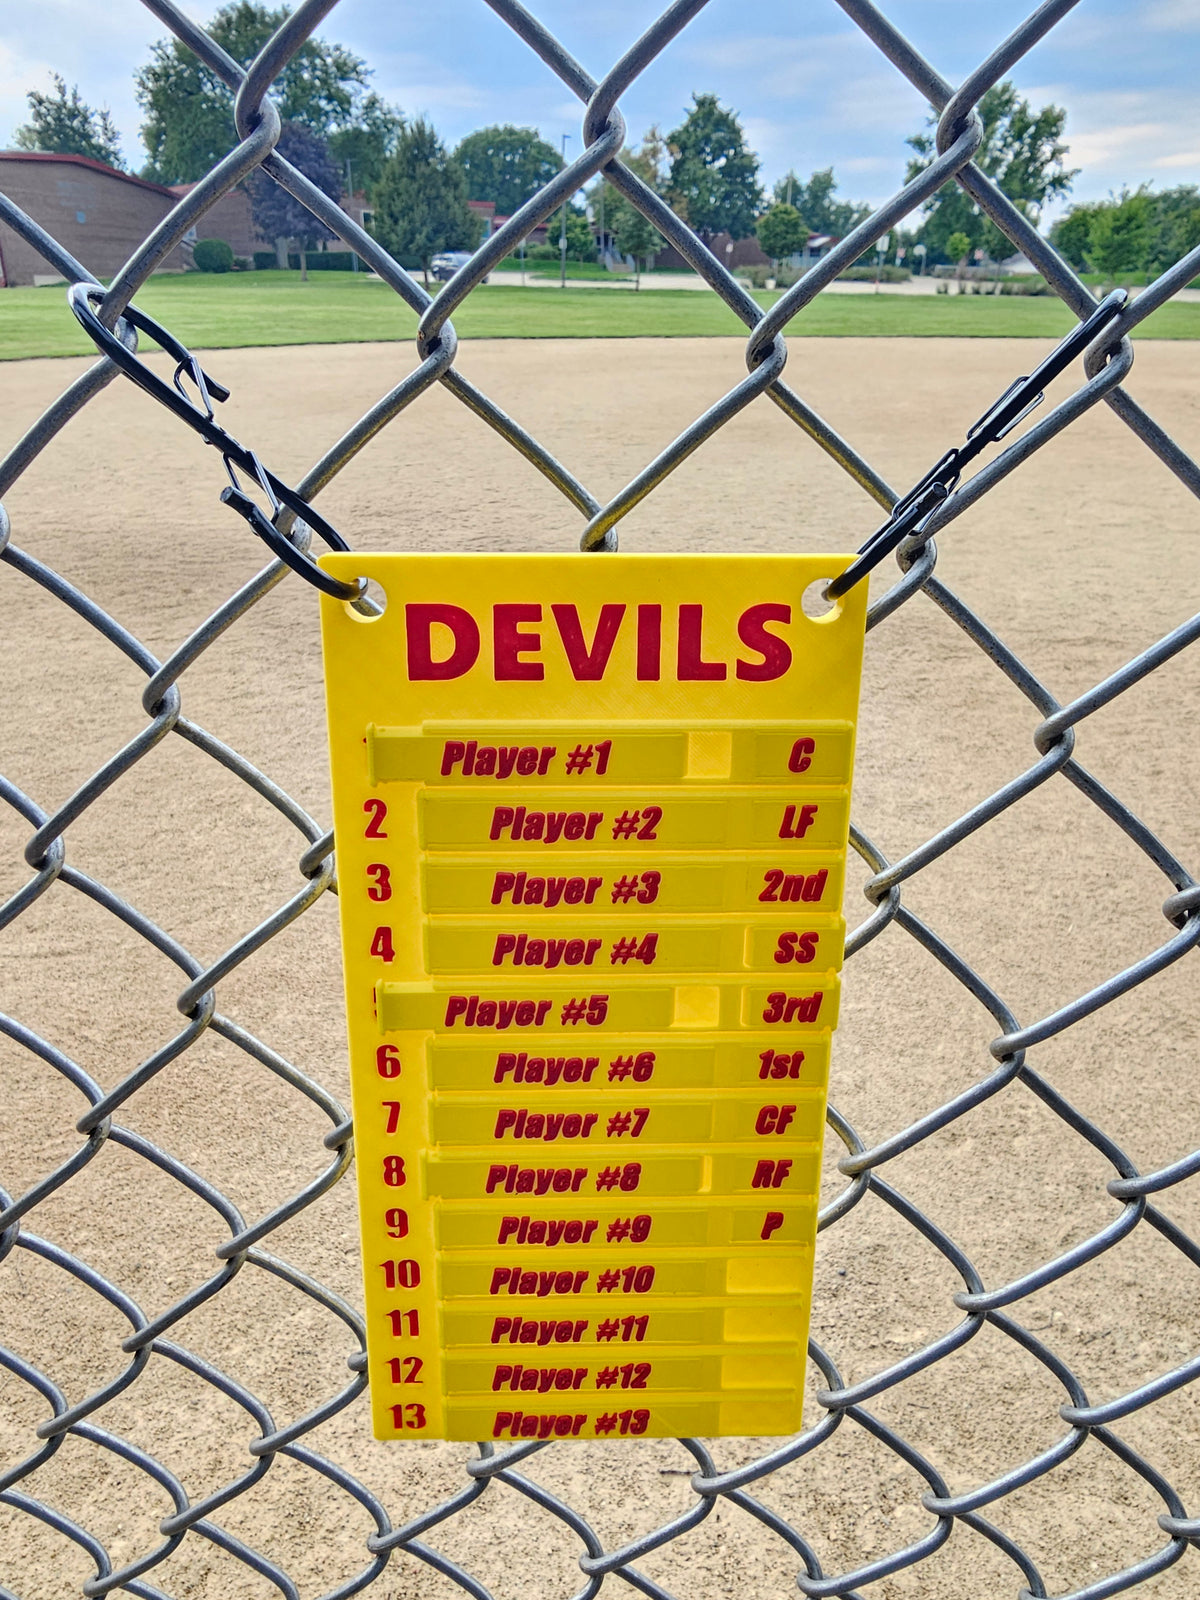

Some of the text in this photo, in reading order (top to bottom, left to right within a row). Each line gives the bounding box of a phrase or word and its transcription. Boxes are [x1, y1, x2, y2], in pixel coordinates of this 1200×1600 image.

[404, 603, 793, 682] DEVILS
[440, 737, 816, 780] Player #1 C
[363, 798, 819, 845] 2 Player #2 LF
[366, 863, 829, 909] 3 Player #3 2nd
[370, 926, 820, 969] 4 Player #4 SS
[444, 991, 824, 1030] Player #5 3rd
[376, 1044, 805, 1087] 6 Player #6 1st
[381, 1101, 797, 1142] 7 Player #7 CF
[382, 1155, 793, 1196] 8 Player #8 RF
[385, 1207, 785, 1247] 9 Player #9 P
[379, 1259, 656, 1298] 10 Player #10
[385, 1308, 650, 1347] 11 Player #11
[386, 1356, 652, 1394] 12 Player #12
[388, 1403, 651, 1440] 13 Player #13
